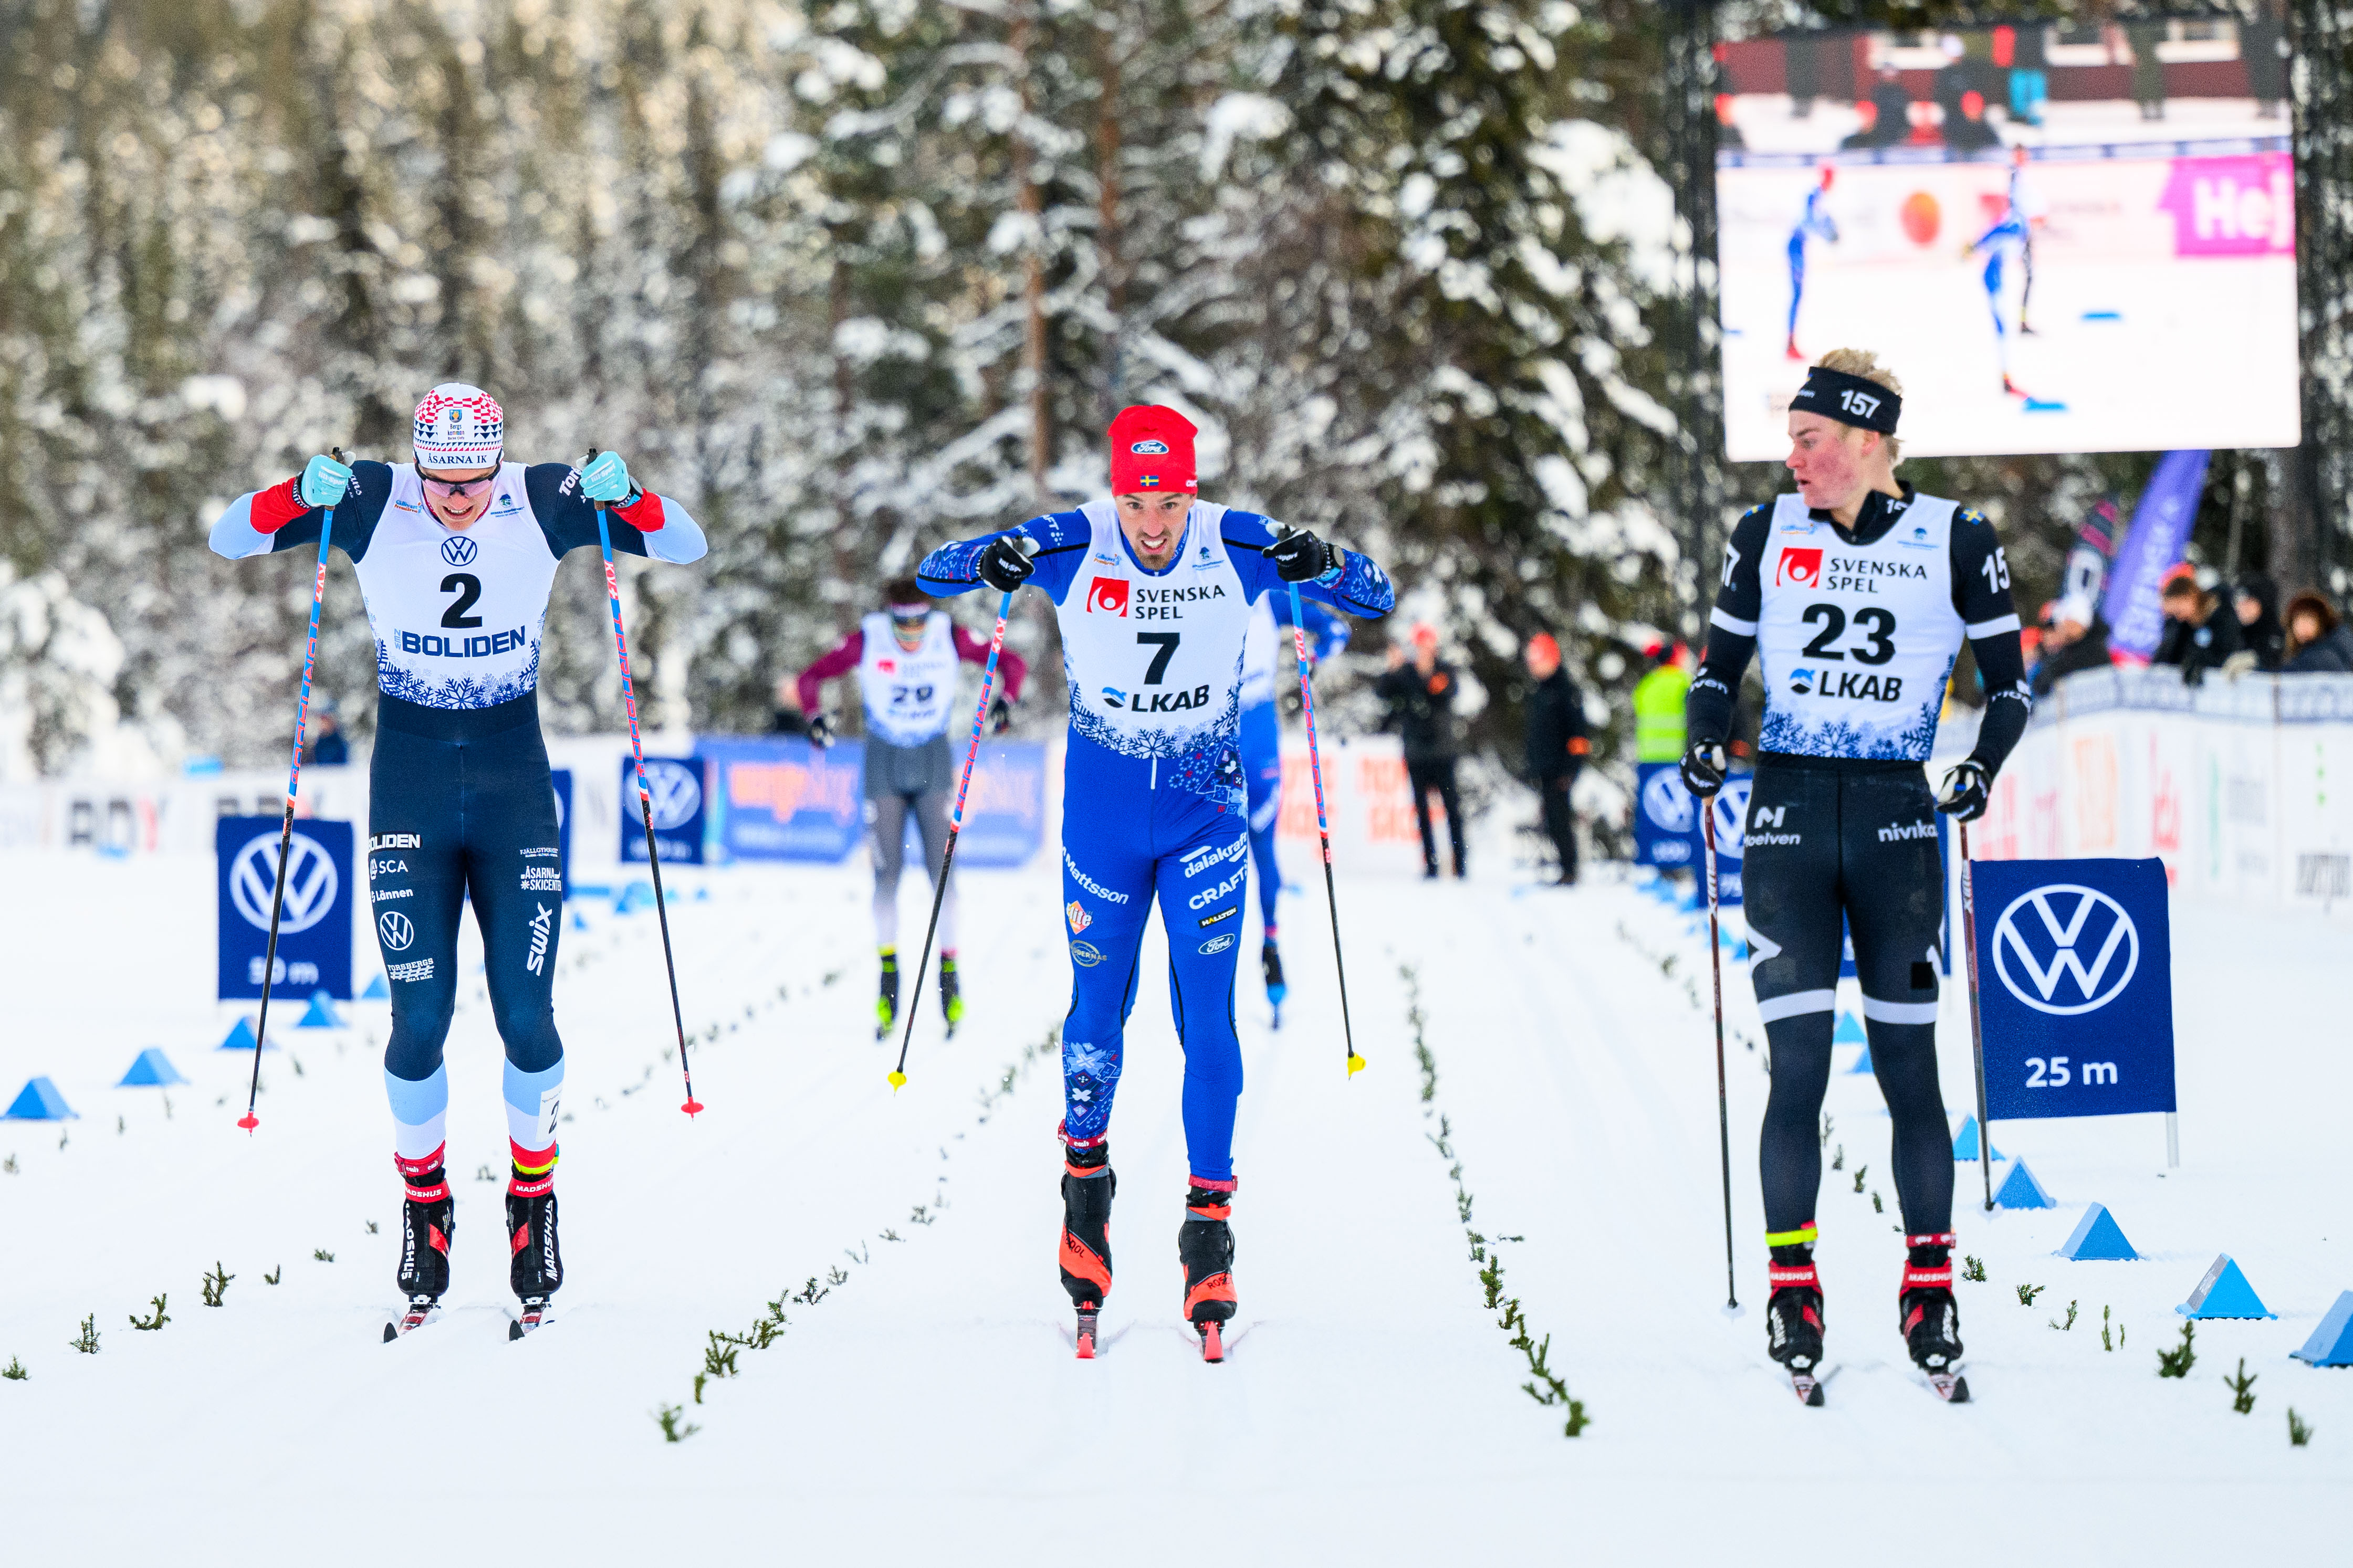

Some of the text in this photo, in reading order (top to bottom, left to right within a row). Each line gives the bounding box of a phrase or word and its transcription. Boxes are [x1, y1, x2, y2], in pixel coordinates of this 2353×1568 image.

[1841, 390, 1880, 419] 157
[427, 453, 487, 464] ÅSARNA IK
[1137, 442, 1163, 452] Ford
[1829, 557, 1927, 580] SVENSKA
[1136, 585, 1226, 603] SVENSKA
[1826, 576, 1878, 593] SPEL
[440, 573, 483, 629] 2
[1135, 606, 1183, 620] SPEL
[402, 625, 525, 658] BOLIDEN
[1802, 603, 1896, 666] 23
[1137, 632, 1180, 685] 7
[1131, 684, 1209, 712] LKAB
[1818, 670, 1902, 702] LKAB
[379, 860, 409, 874] SCA
[525, 866, 555, 879] ÅSARNA
[1065, 853, 1129, 904] Mattsson
[376, 888, 413, 901] Lännen
[1189, 866, 1245, 910] CRAFT
[1207, 935, 1231, 953] Ford
[2025, 1056, 2118, 1088] 25 m
